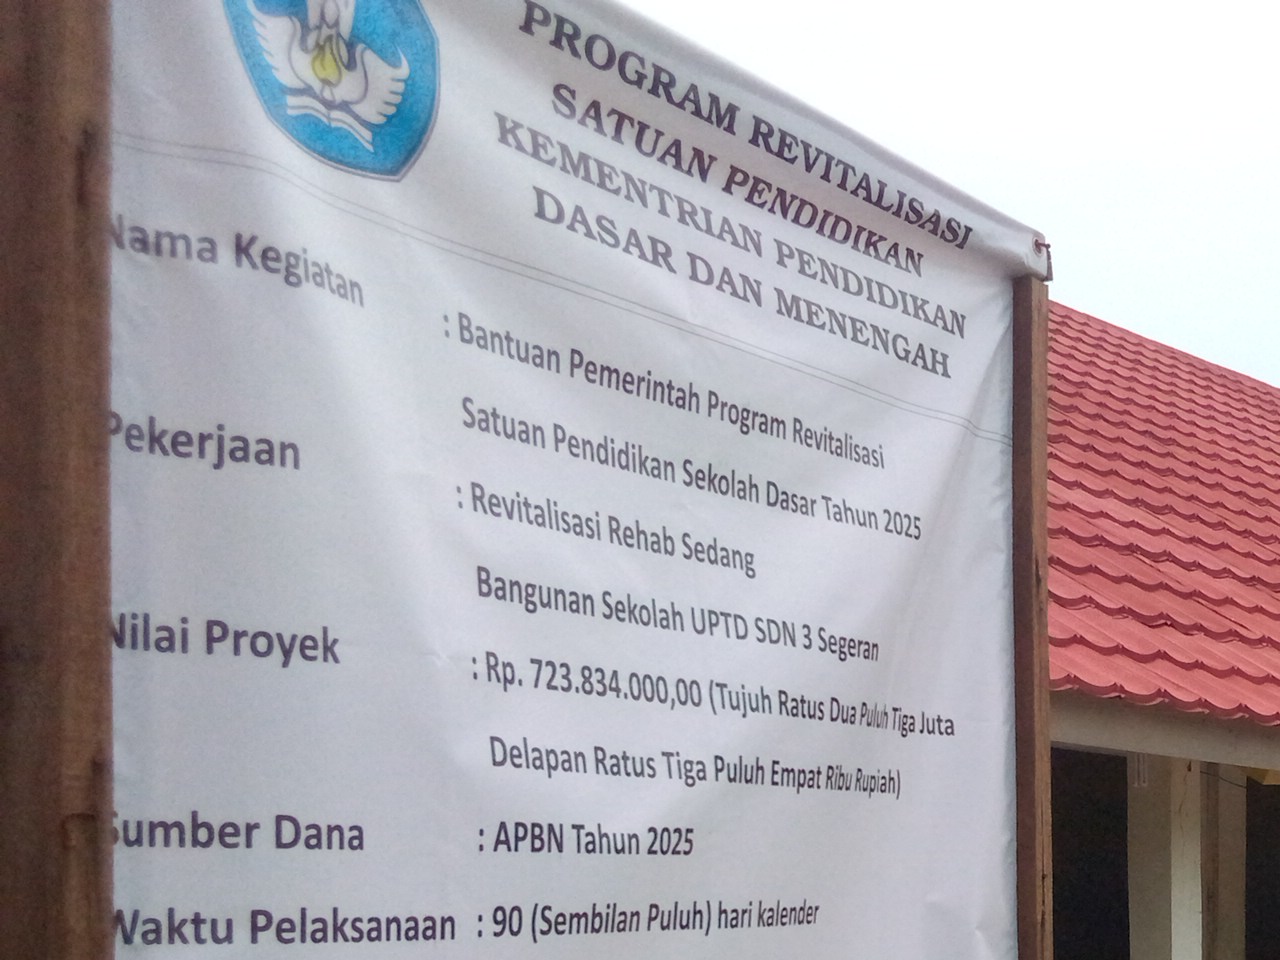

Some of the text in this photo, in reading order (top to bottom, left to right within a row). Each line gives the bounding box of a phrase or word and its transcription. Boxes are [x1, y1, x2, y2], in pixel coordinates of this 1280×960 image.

[518, 0, 974, 251] PROGRAM REVITALISASI
[552, 82, 924, 278] SATUAN PENDIDIKAN
[494, 111, 967, 339] KEMENTRIAN PENDIDIKAN
[532, 185, 952, 379] DASAR DAN MENENGAH
[233, 231, 364, 307] Kegiatan
[457, 311, 561, 374] Bantuan
[569, 347, 701, 415] Pemerintah
[707, 389, 787, 440] Program
[792, 416, 885, 469] Revitalisasi
[461, 396, 922, 541] Satuan Pendidikan Sekolah Dasar Tahun 2025
[470, 481, 602, 541] Revitalisasi
[607, 514, 676, 557] Rehab
[681, 531, 757, 580] Sedang
[205, 618, 341, 669] Proyek
[484, 650, 524, 693] Rp.
[529, 657, 703, 711] 723.834.000,00
[708, 679, 773, 719] (Tujuh
[777, 689, 826, 722] Ratus
[829, 696, 858, 726] Dua
[859, 701, 889, 729] Puluh
[891, 706, 916, 739] Tiga
[918, 711, 956, 737] Juta
[476, 565, 880, 663] Bangunan Sekolah UPTD SDN 3 Segeran
[111, 809, 261, 850] umber
[274, 813, 365, 852] Dana
[492, 820, 564, 854] APBN
[570, 822, 641, 856] Tahun
[646, 826, 695, 857] 2025
[488, 735, 901, 800] Delapan Ratus Tiga Puluh Empat Ribu Rupiah)
[249, 906, 456, 946] Pelaksanaan
[491, 904, 524, 938] 90
[530, 902, 641, 945] (Sembilan
[646, 899, 712, 937] Puluh)
[717, 900, 754, 930] hari
[756, 899, 820, 928] kalender
